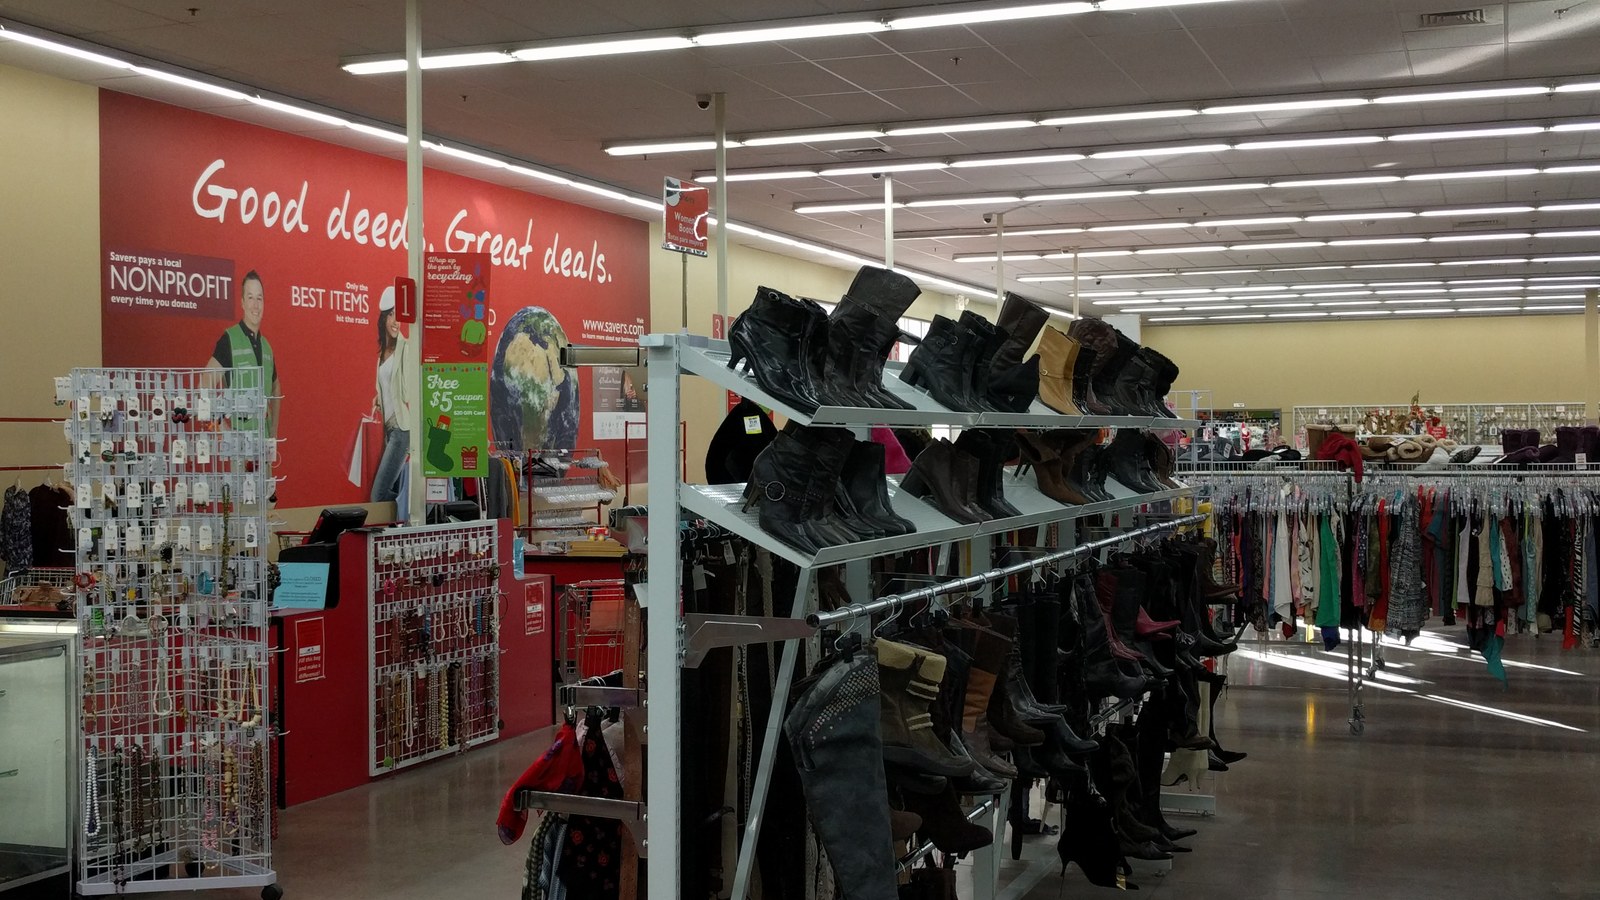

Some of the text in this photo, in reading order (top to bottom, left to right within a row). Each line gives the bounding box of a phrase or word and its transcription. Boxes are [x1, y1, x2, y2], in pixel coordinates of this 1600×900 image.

[192, 158, 612, 284] Good deed. Great deals.
[110, 251, 137, 263] Savers
[138, 256, 156, 267] pays
[164, 257, 182, 268] local
[427, 255, 447, 265] Wrap
[452, 262, 462, 272] by
[110, 264, 232, 300] NONPROFIT
[427, 270, 474, 284] recycling
[346, 281, 369, 292] Only the
[111, 295, 198, 310] every time you donate
[291, 285, 370, 314] BEST ITEMS
[401, 284, 410, 317] 1
[335, 314, 344, 323] hit
[345, 315, 355, 324] the
[582, 319, 645, 336] www.savers.com
[427, 374, 460, 390] Free
[430, 390, 484, 413] $5 coupon
